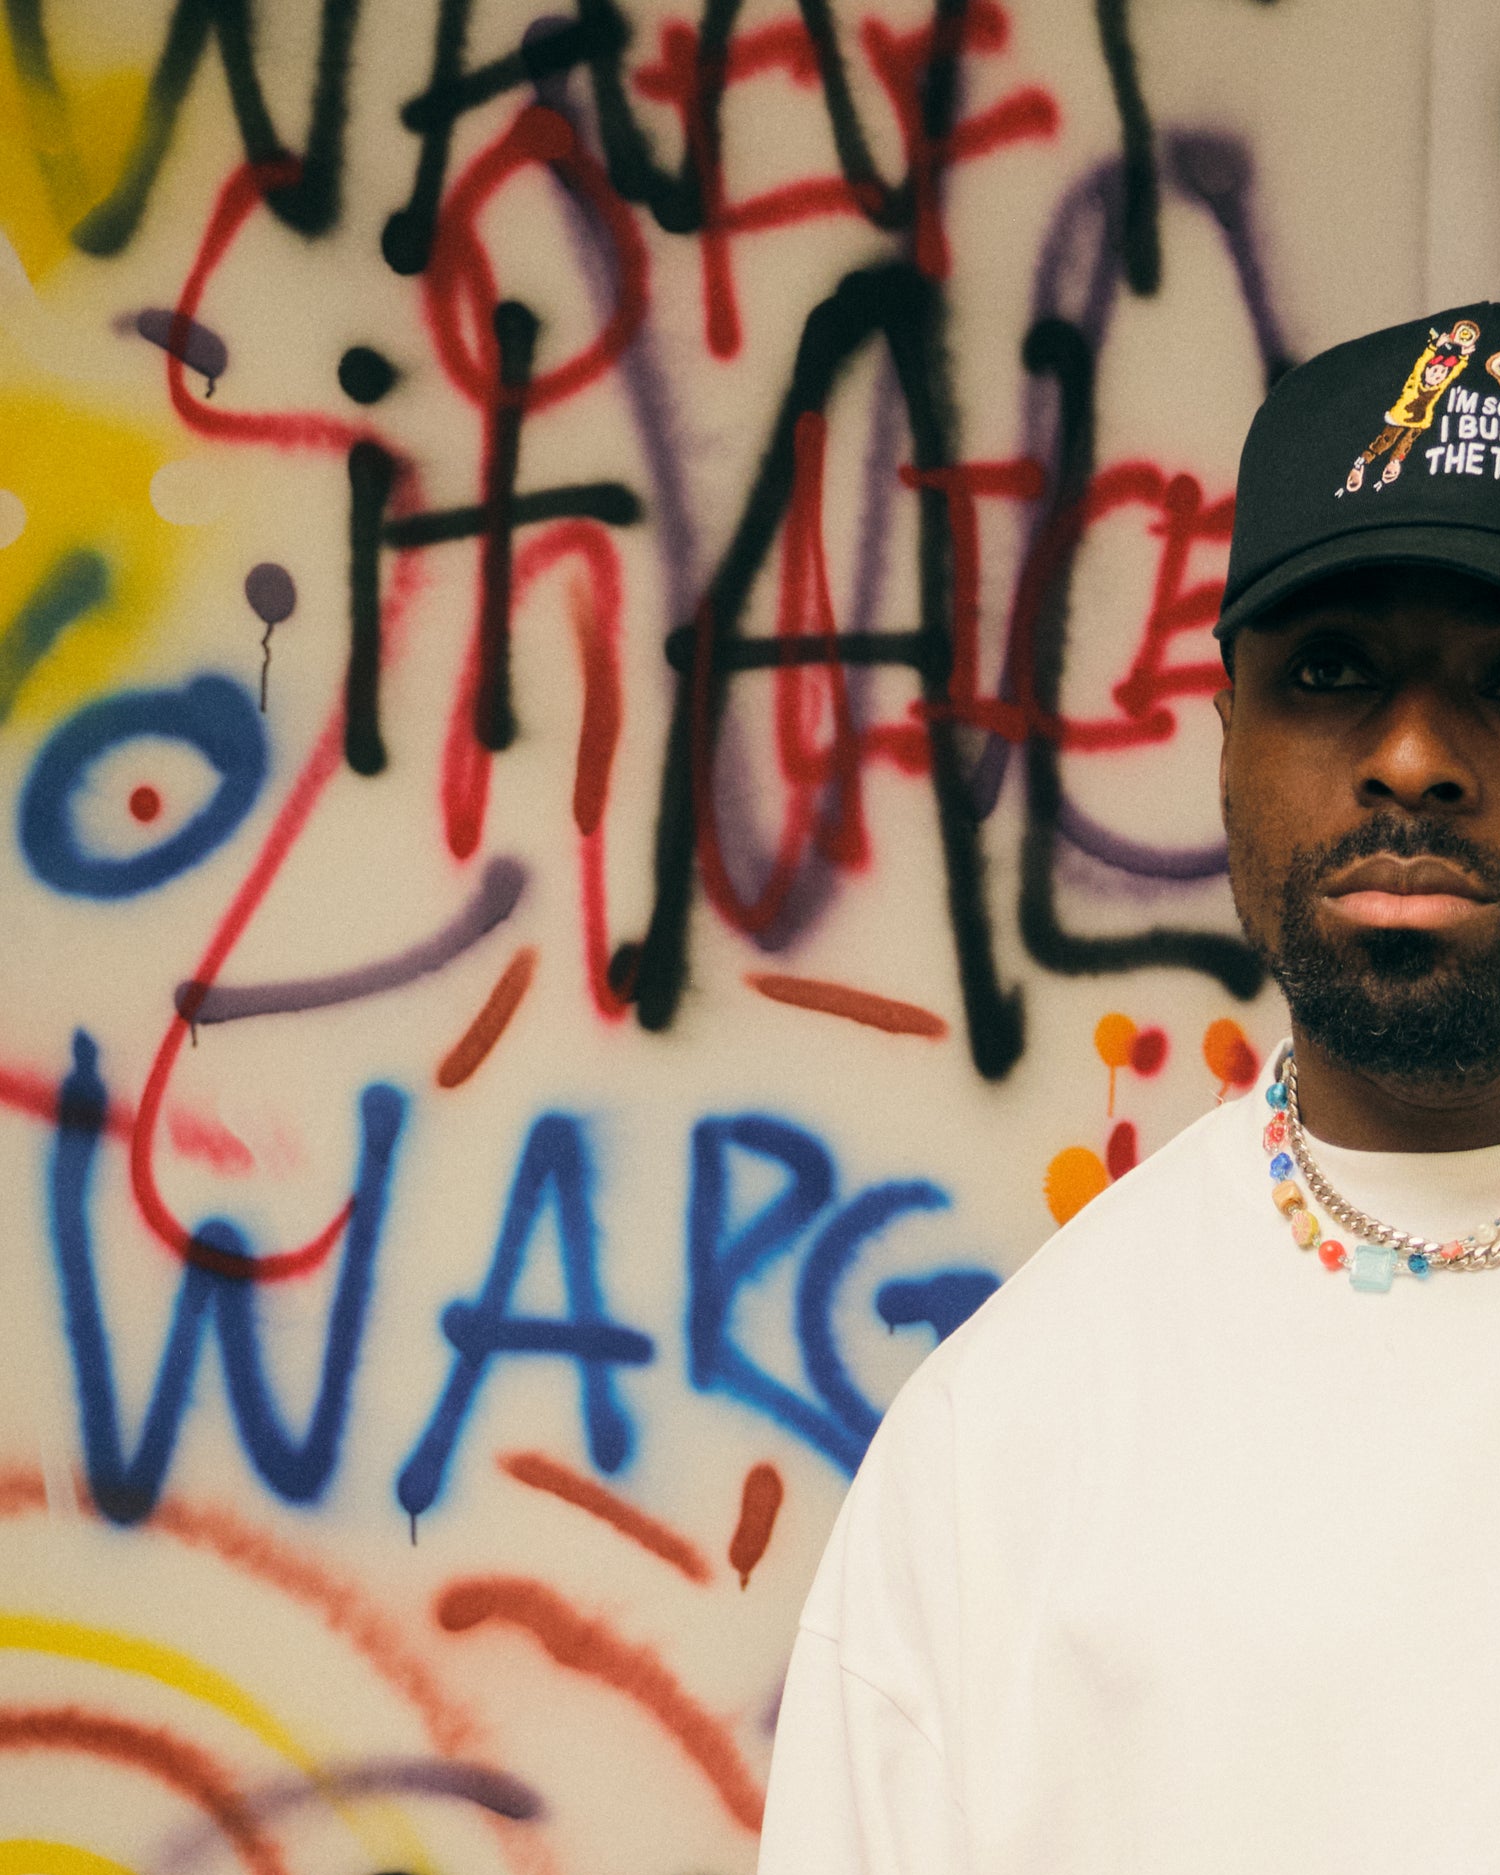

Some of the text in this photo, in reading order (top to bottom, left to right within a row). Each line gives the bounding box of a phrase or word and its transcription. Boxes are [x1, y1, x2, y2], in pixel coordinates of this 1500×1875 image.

[1447, 386, 1478, 413] I'M
[1441, 415, 1449, 442] I
[1425, 443, 1484, 475] THE
